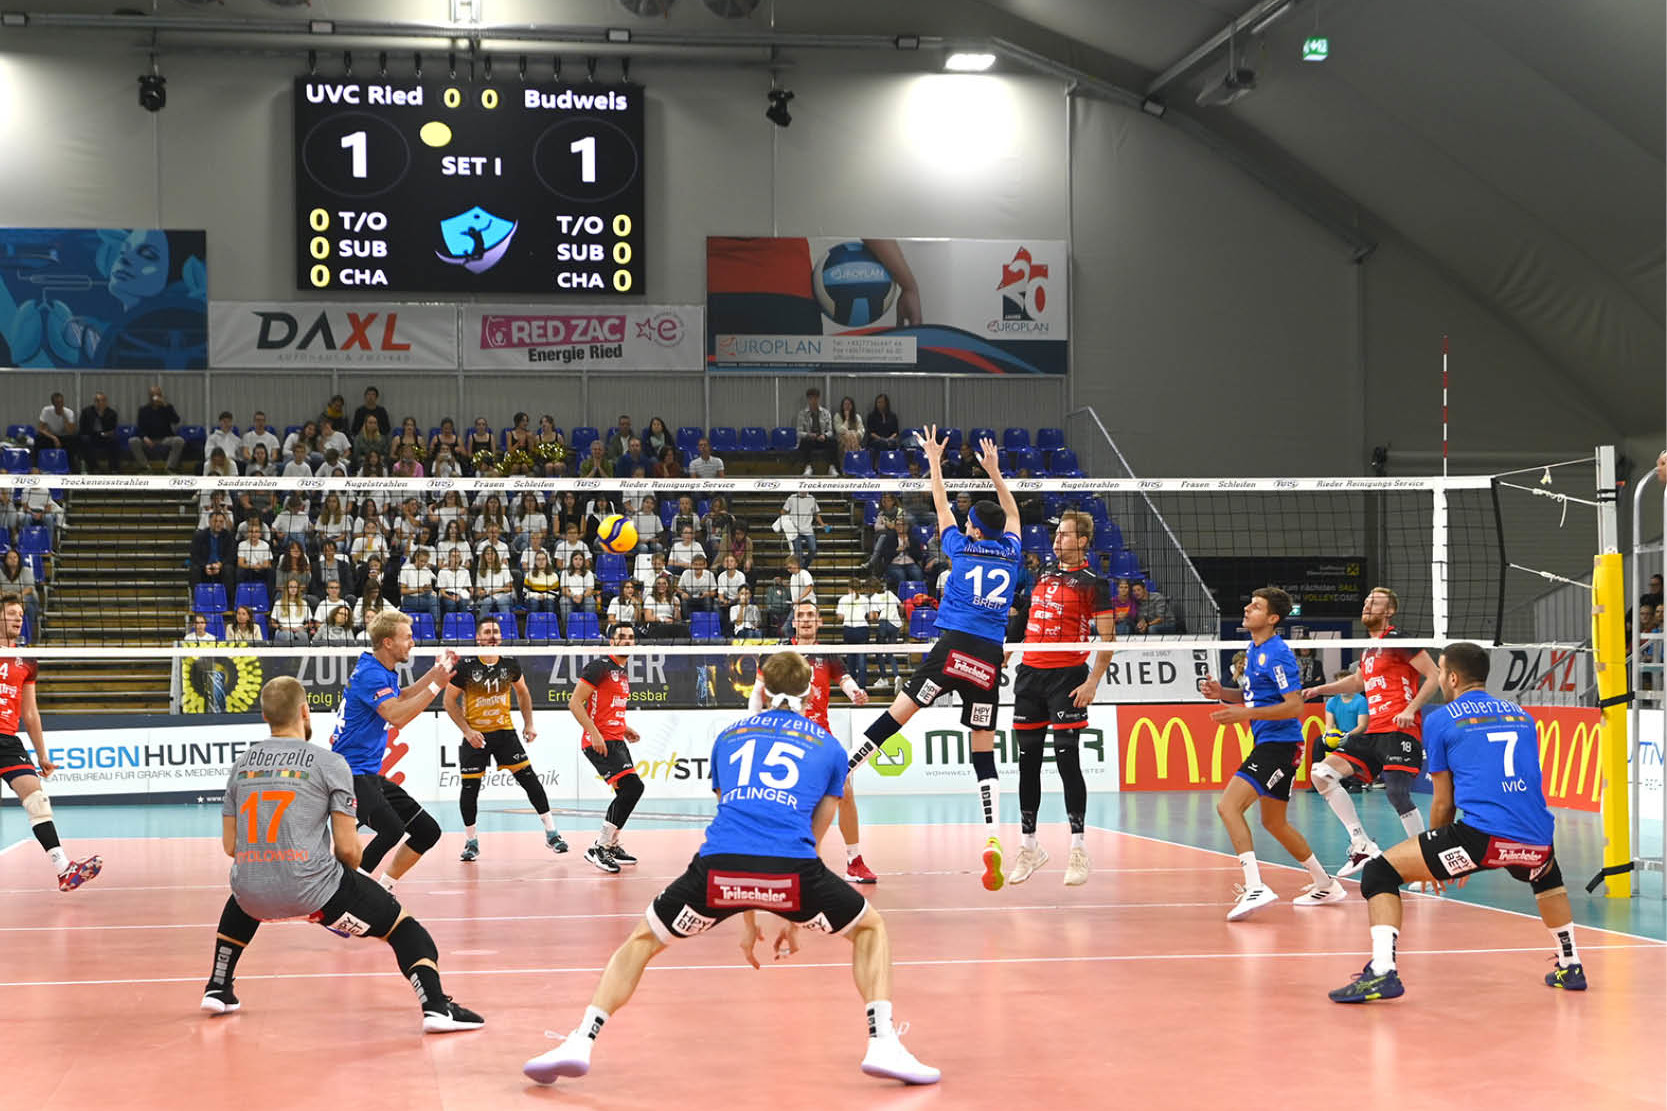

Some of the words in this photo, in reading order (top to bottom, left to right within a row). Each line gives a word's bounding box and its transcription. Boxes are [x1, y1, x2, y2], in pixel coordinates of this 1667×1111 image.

[306, 84, 361, 104] UVC
[368, 86, 424, 106] Ried
[443, 88, 462, 109] 0
[481, 89, 499, 109] 0
[524, 90, 628, 110] Budweis
[341, 131, 368, 178] 1
[442, 156, 487, 176] SET
[570, 136, 596, 183] 1
[309, 208, 330, 232] 0
[339, 211, 388, 233] T/O
[556, 215, 604, 236] T/O
[612, 214, 632, 237] 0
[309, 236, 330, 260] 0
[339, 239, 388, 258] SUB
[557, 243, 604, 262] SUB
[612, 241, 632, 265] 0
[310, 264, 330, 287] 0
[339, 268, 388, 286] CHA
[557, 271, 604, 289] CHA
[612, 269, 633, 292] 0
[251, 309, 411, 351] DAXL
[511, 320, 566, 345] RED
[571, 318, 622, 342] ZAC
[528, 346, 586, 364] Energie
[590, 344, 623, 360] Ried
[943, 481, 995, 489] Sandstrahle
[964, 565, 1011, 604] 12
[1106, 660, 1178, 686] RIED
[483, 678, 500, 694] 11
[629, 689, 667, 702] ssbar
[307, 691, 335, 708] folg
[1401, 741, 1412, 753] 18
[1487, 731, 1519, 778] 7
[728, 738, 807, 790] 15
[240, 790, 297, 844] 17
